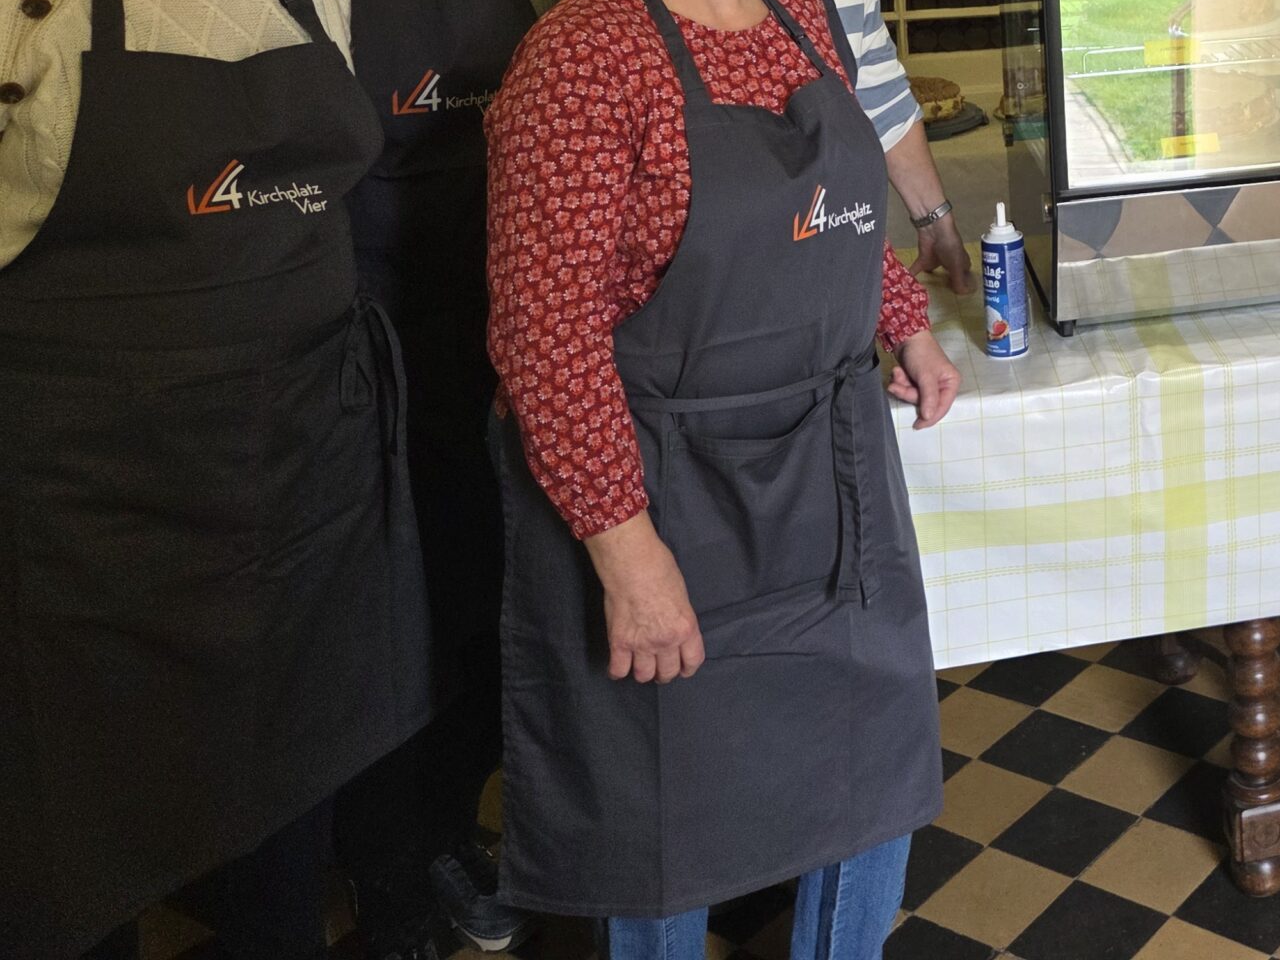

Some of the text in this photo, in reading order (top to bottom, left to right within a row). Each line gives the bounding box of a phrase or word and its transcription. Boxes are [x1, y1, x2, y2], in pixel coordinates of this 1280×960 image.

[414, 73, 442, 111] 4
[211, 163, 323, 209] 4 Kirchplatz
[294, 199, 328, 215] Vier
[809, 187, 873, 233] 4 Kirchplatz
[852, 219, 876, 235] Vier
